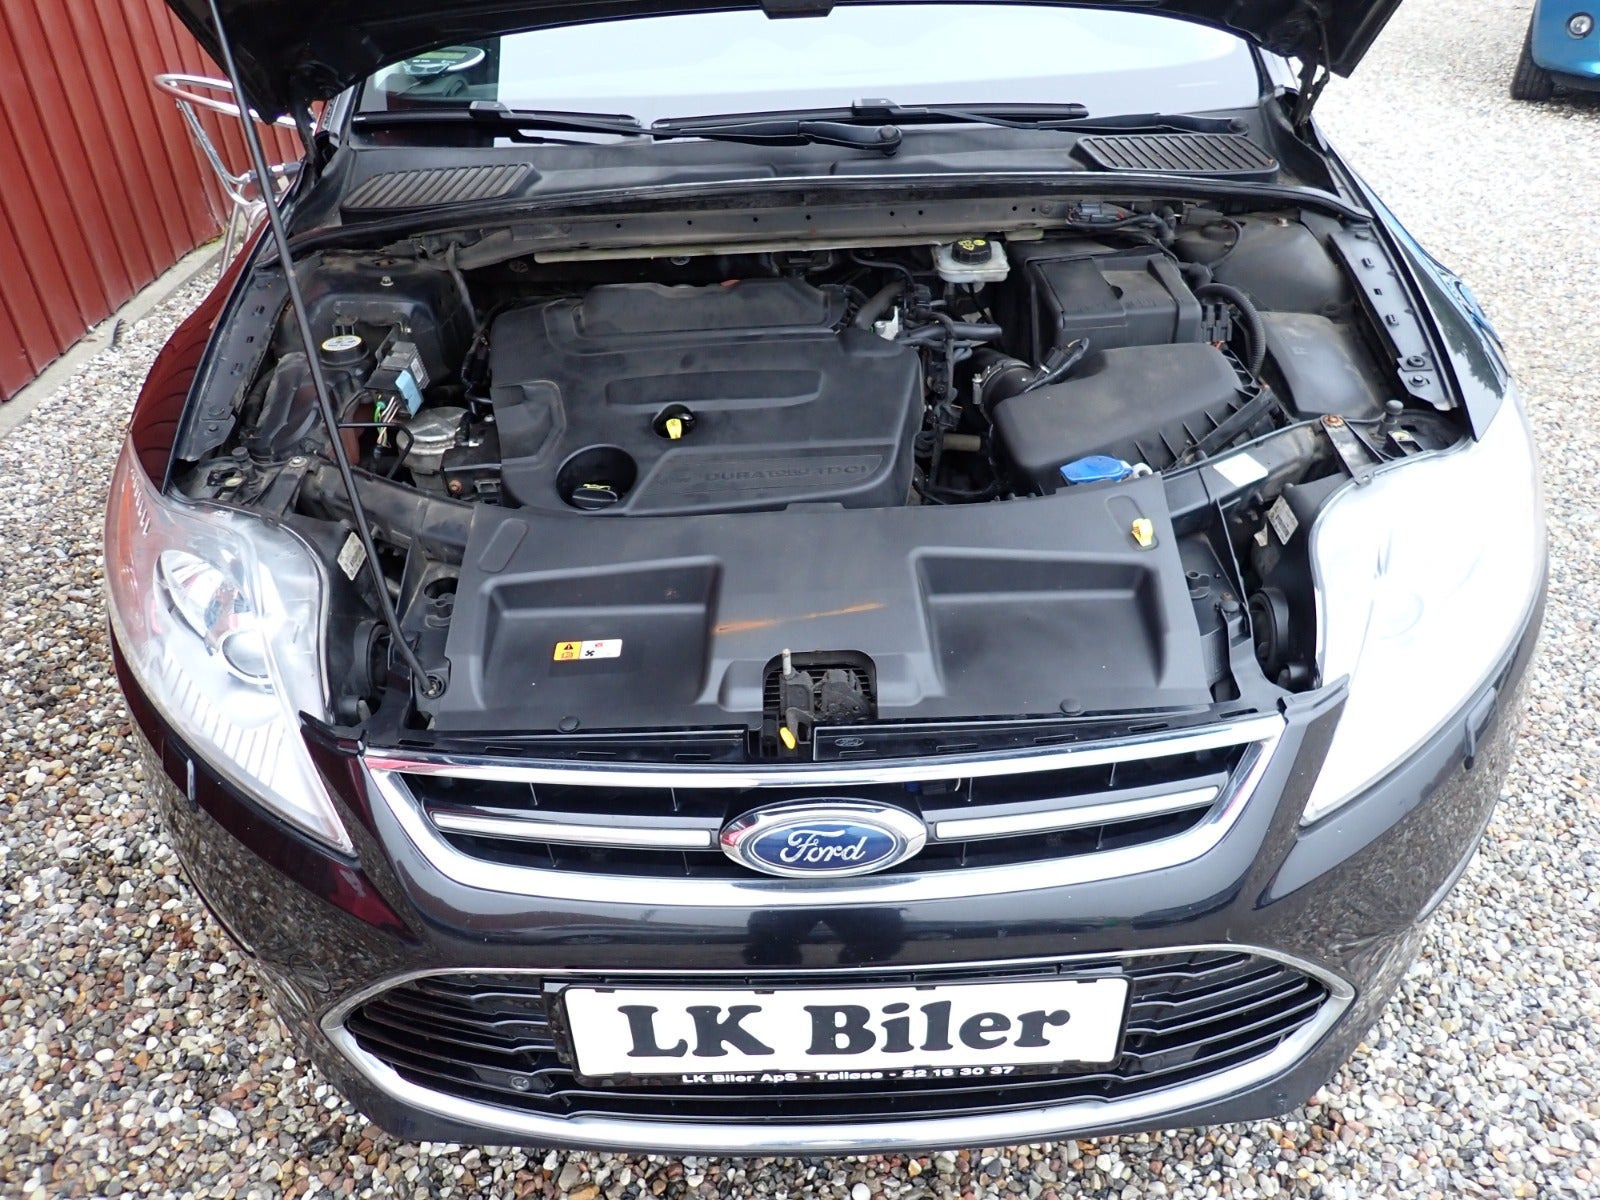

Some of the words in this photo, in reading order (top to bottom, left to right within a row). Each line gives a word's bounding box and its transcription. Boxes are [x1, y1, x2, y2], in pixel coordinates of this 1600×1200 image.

[780, 829, 868, 863] Ford
[617, 1004, 775, 1058] LK
[803, 1000, 1071, 1056] Biler
[682, 1074, 707, 1084] LK
[712, 1074, 756, 1083] Biler
[760, 1073, 798, 1084] ApS
[902, 1069, 928, 1078] 22
[933, 1068, 954, 1077] 16
[960, 1067, 985, 1076] 30
[990, 1066, 1015, 1075] 37
